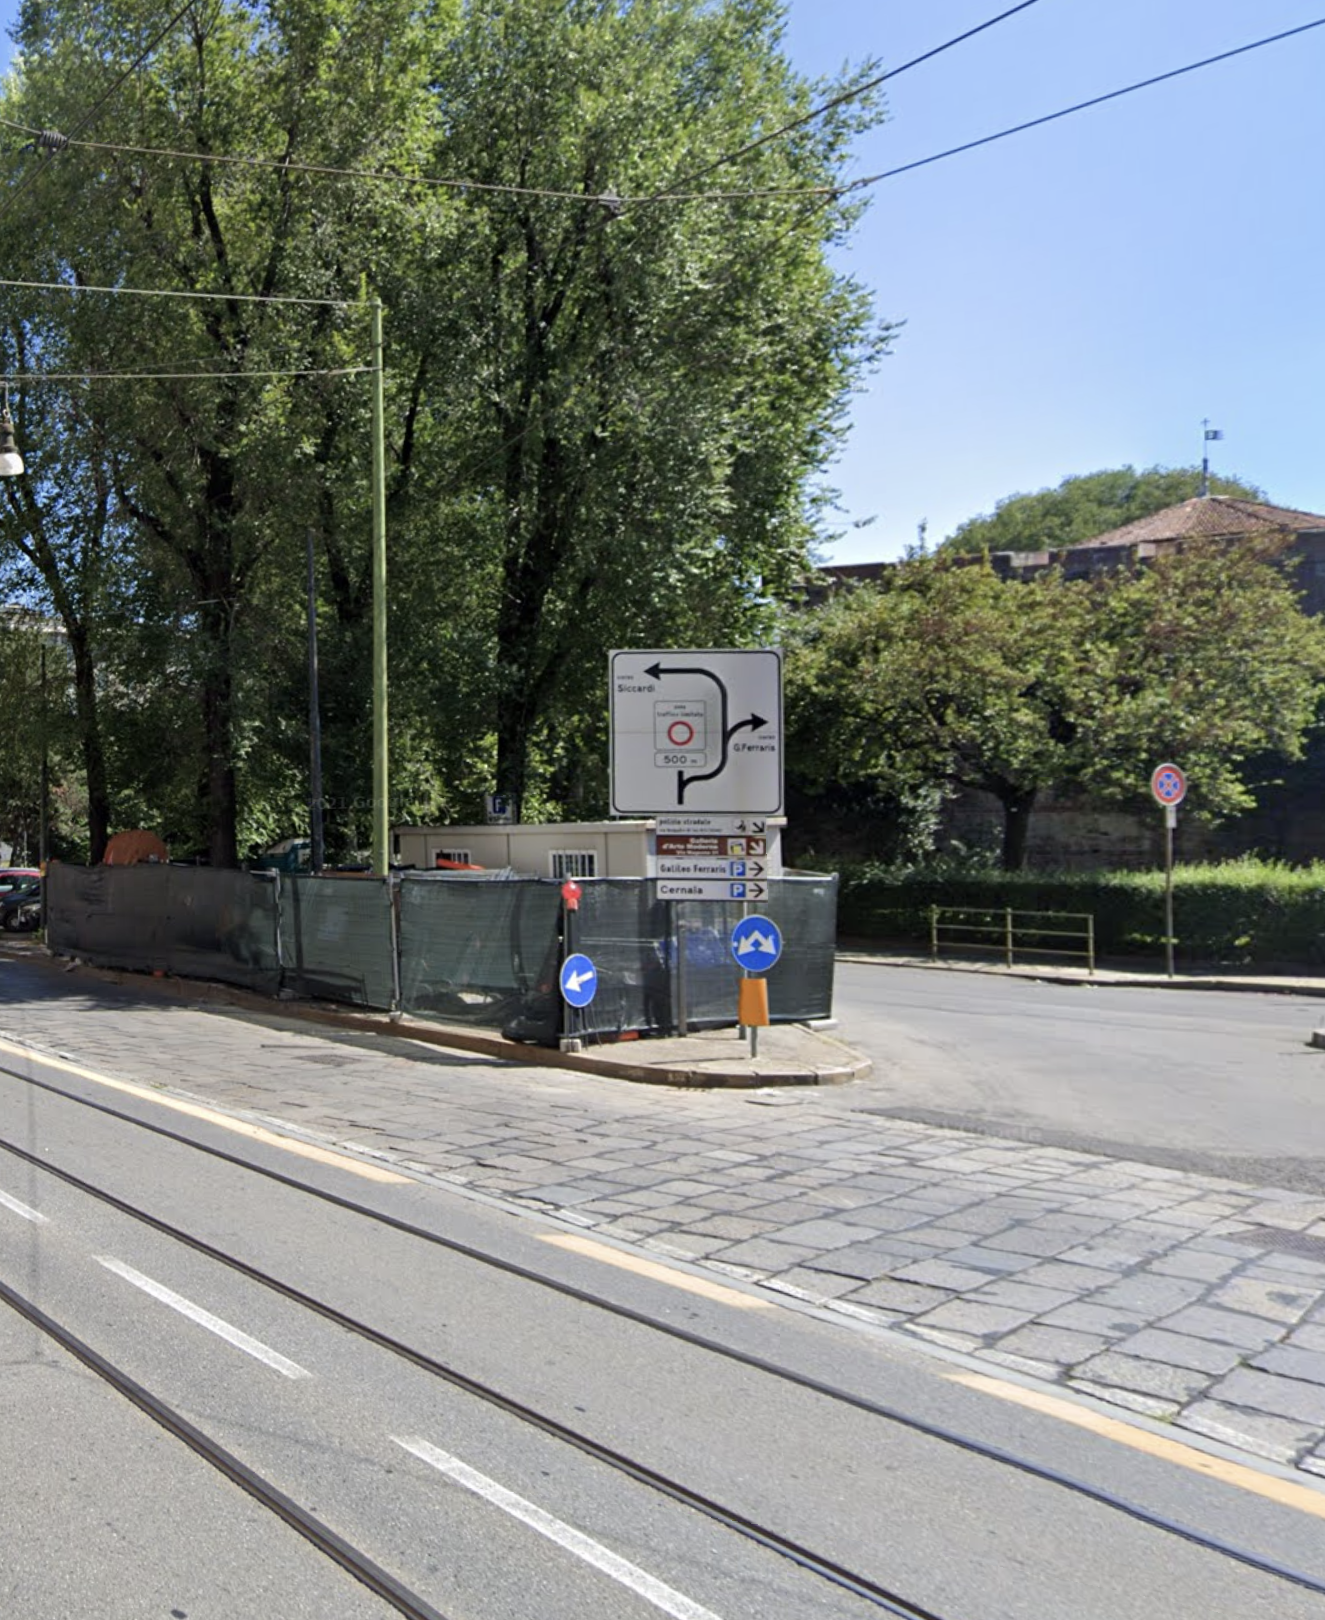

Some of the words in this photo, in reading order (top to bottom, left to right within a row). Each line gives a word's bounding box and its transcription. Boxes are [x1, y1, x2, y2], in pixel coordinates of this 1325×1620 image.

[617, 684, 655, 693] Siccardi
[664, 755, 688, 764] 500
[660, 863, 691, 873] Galileo
[693, 863, 726, 873] Ferraris
[660, 885, 703, 894] Cernaia
